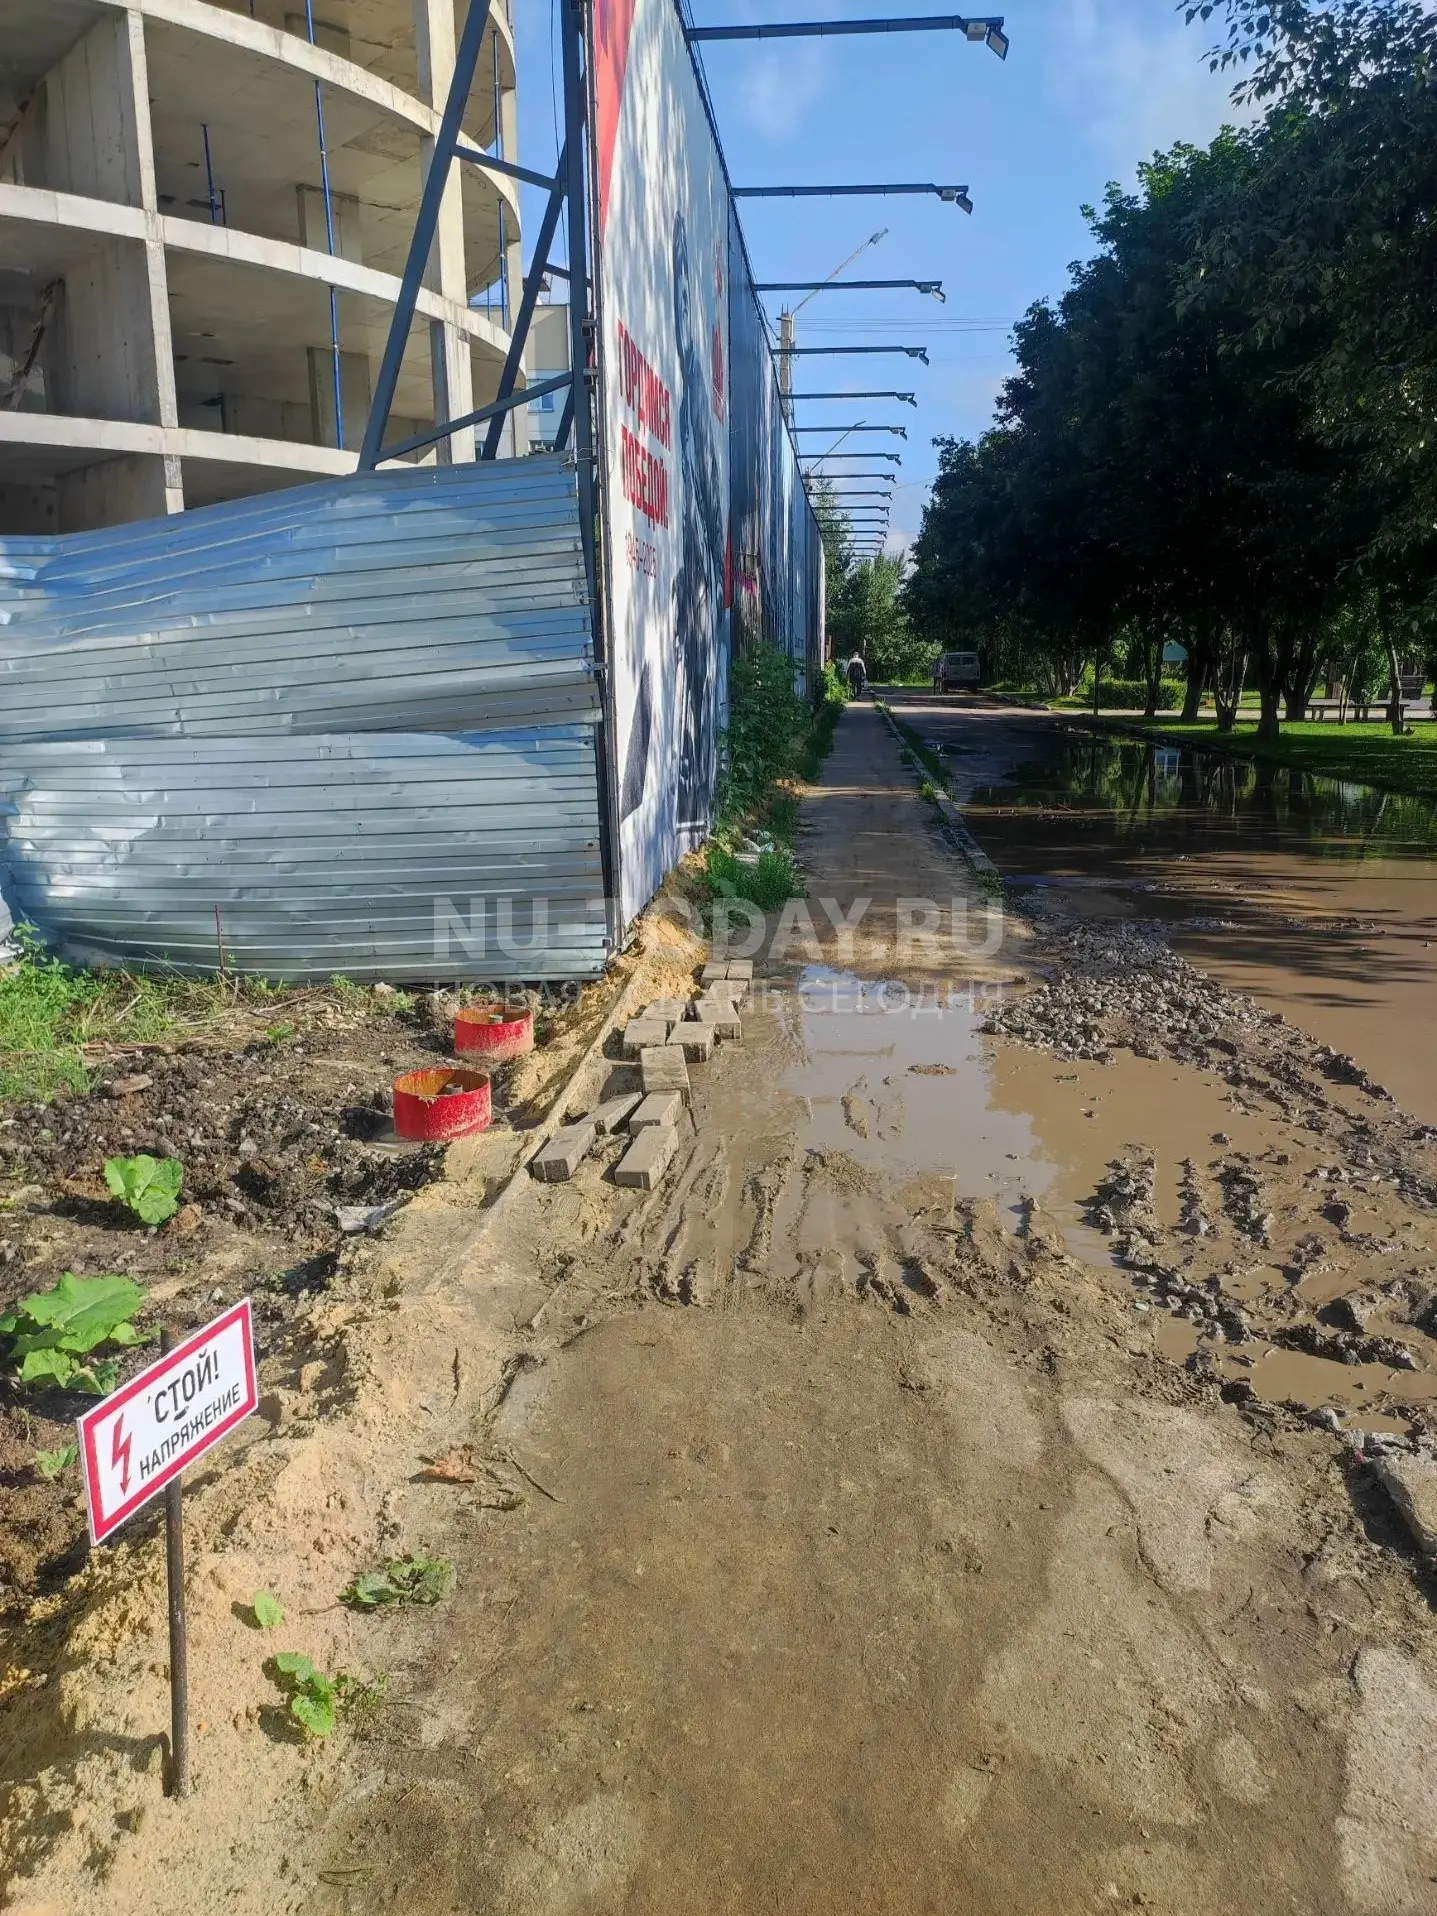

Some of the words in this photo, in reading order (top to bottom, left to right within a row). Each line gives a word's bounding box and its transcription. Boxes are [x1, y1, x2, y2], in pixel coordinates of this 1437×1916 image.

[617, 317, 671, 451] ГОРДИМСЯ
[620, 422, 669, 532] ПОБЕДОЙ!
[139, 1382, 242, 1481] НАПРЯЖЕНИЕ
[153, 1348, 220, 1424] СТОЙ!
